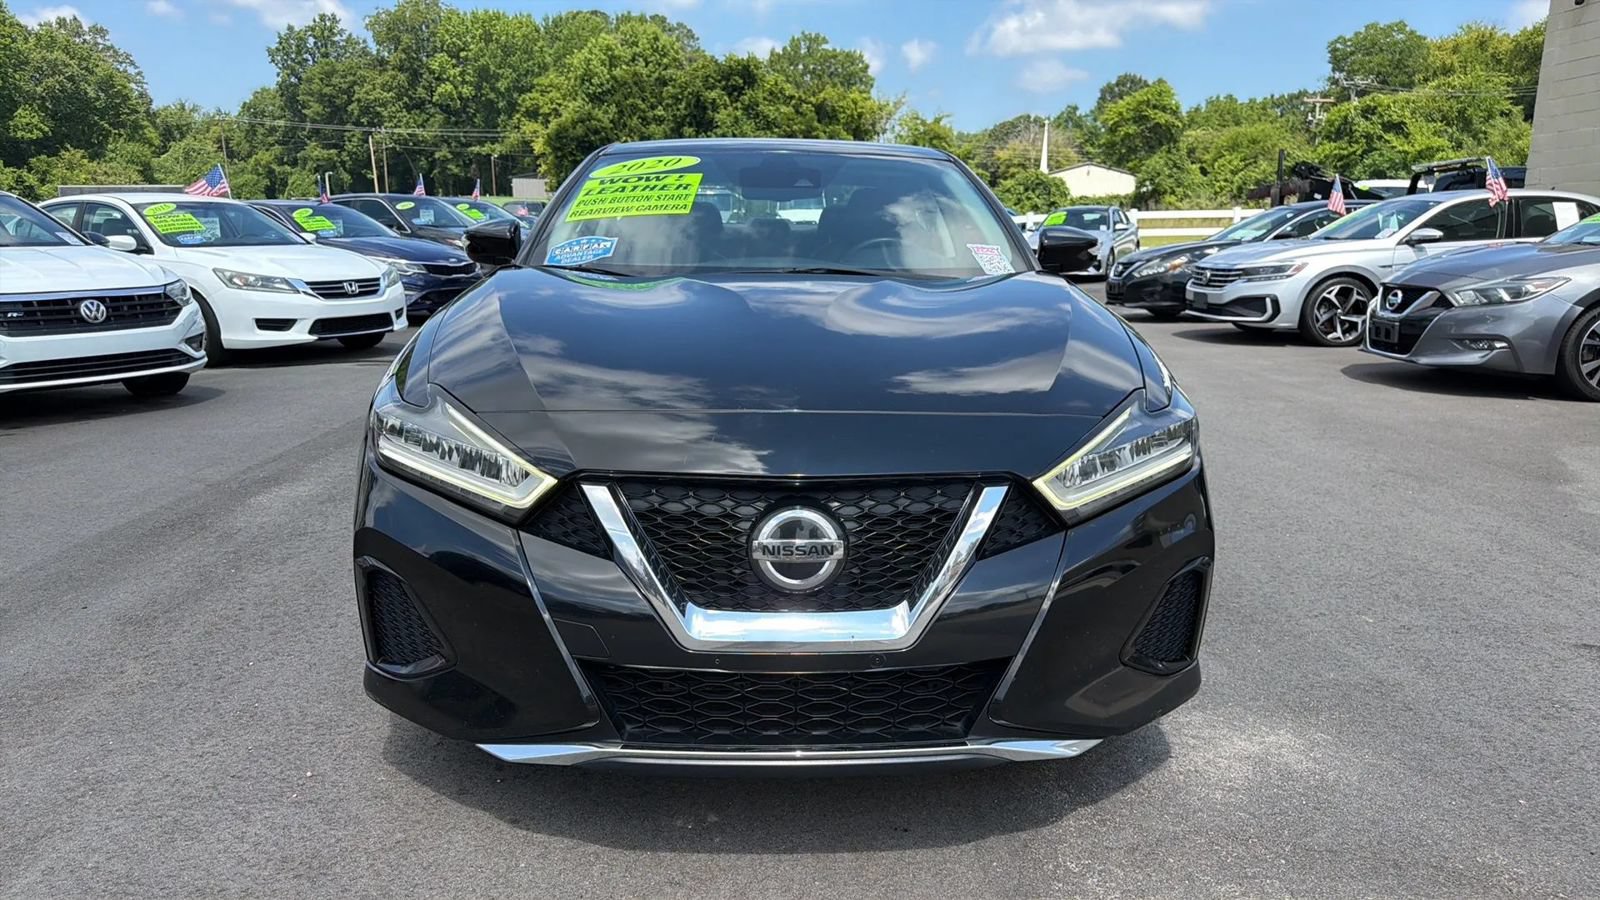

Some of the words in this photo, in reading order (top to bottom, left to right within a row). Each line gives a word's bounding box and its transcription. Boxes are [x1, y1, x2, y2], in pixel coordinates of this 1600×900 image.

[606, 157, 682, 175] 2020
[598, 174, 666, 186] WOW
[582, 182, 692, 197] LEATHER
[575, 198, 606, 208] PUSH
[608, 195, 653, 205] BUTTON
[655, 193, 691, 202] START
[569, 207, 635, 218] REARVIEW
[635, 203, 688, 213] CAMERA
[762, 545, 834, 556] NISSAN
